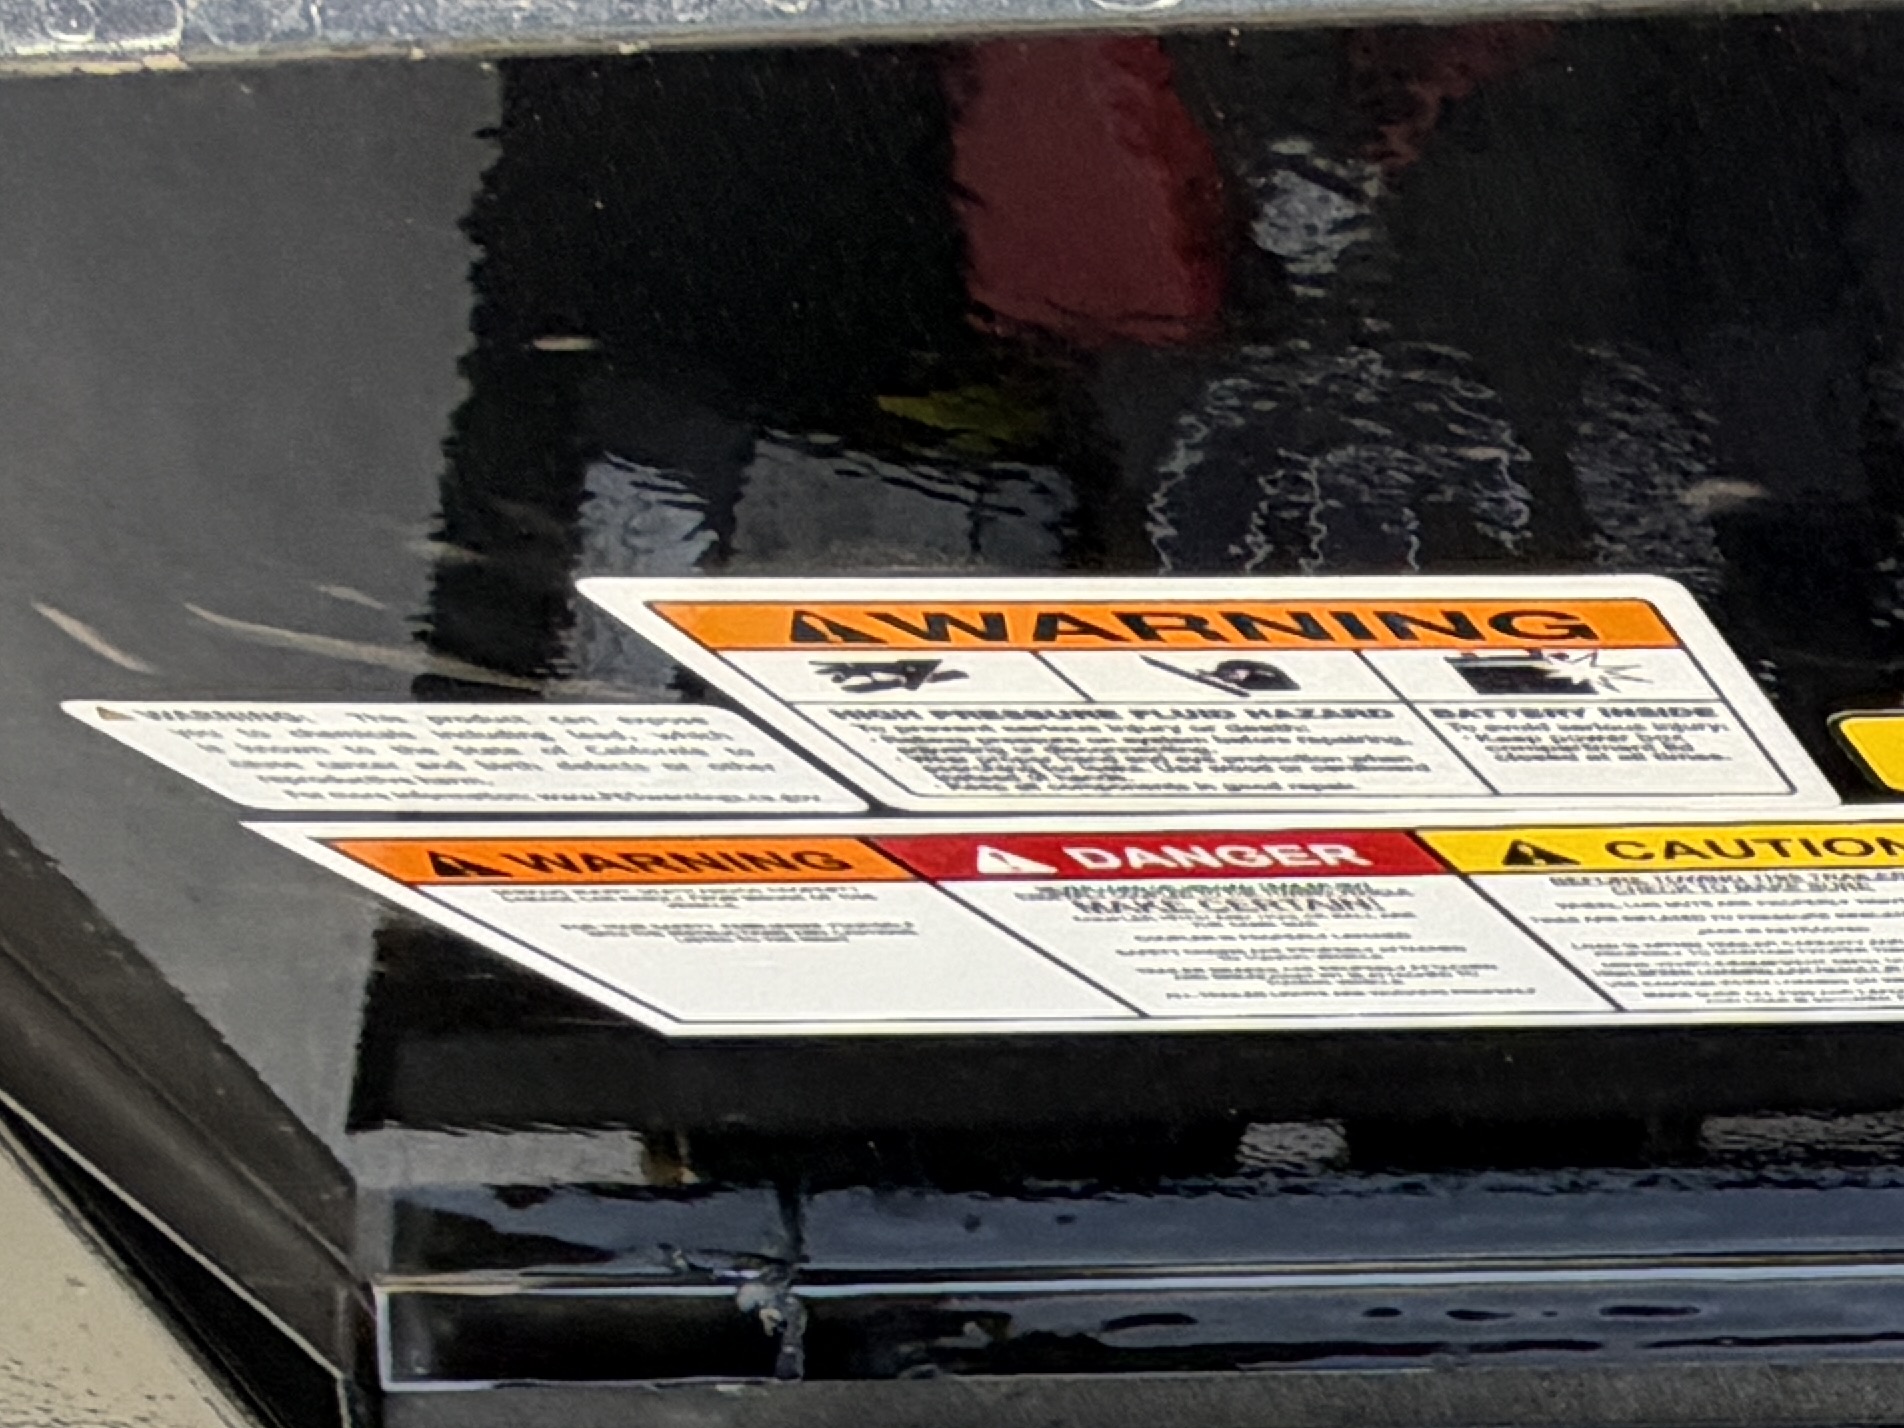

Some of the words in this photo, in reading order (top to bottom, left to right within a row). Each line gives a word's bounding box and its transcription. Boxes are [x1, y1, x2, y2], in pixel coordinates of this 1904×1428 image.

[865, 610, 1600, 643] WARNING
[829, 709, 924, 720] HIGH
[929, 709, 1123, 720] PRESSURE
[1129, 709, 1236, 719] FLUID
[1243, 709, 1394, 719] HAZARD
[1431, 708, 1585, 719] BATTERY
[1598, 707, 1718, 718] INSIDE
[501, 850, 854, 873] WARNING
[1063, 844, 1374, 870] DANGER
